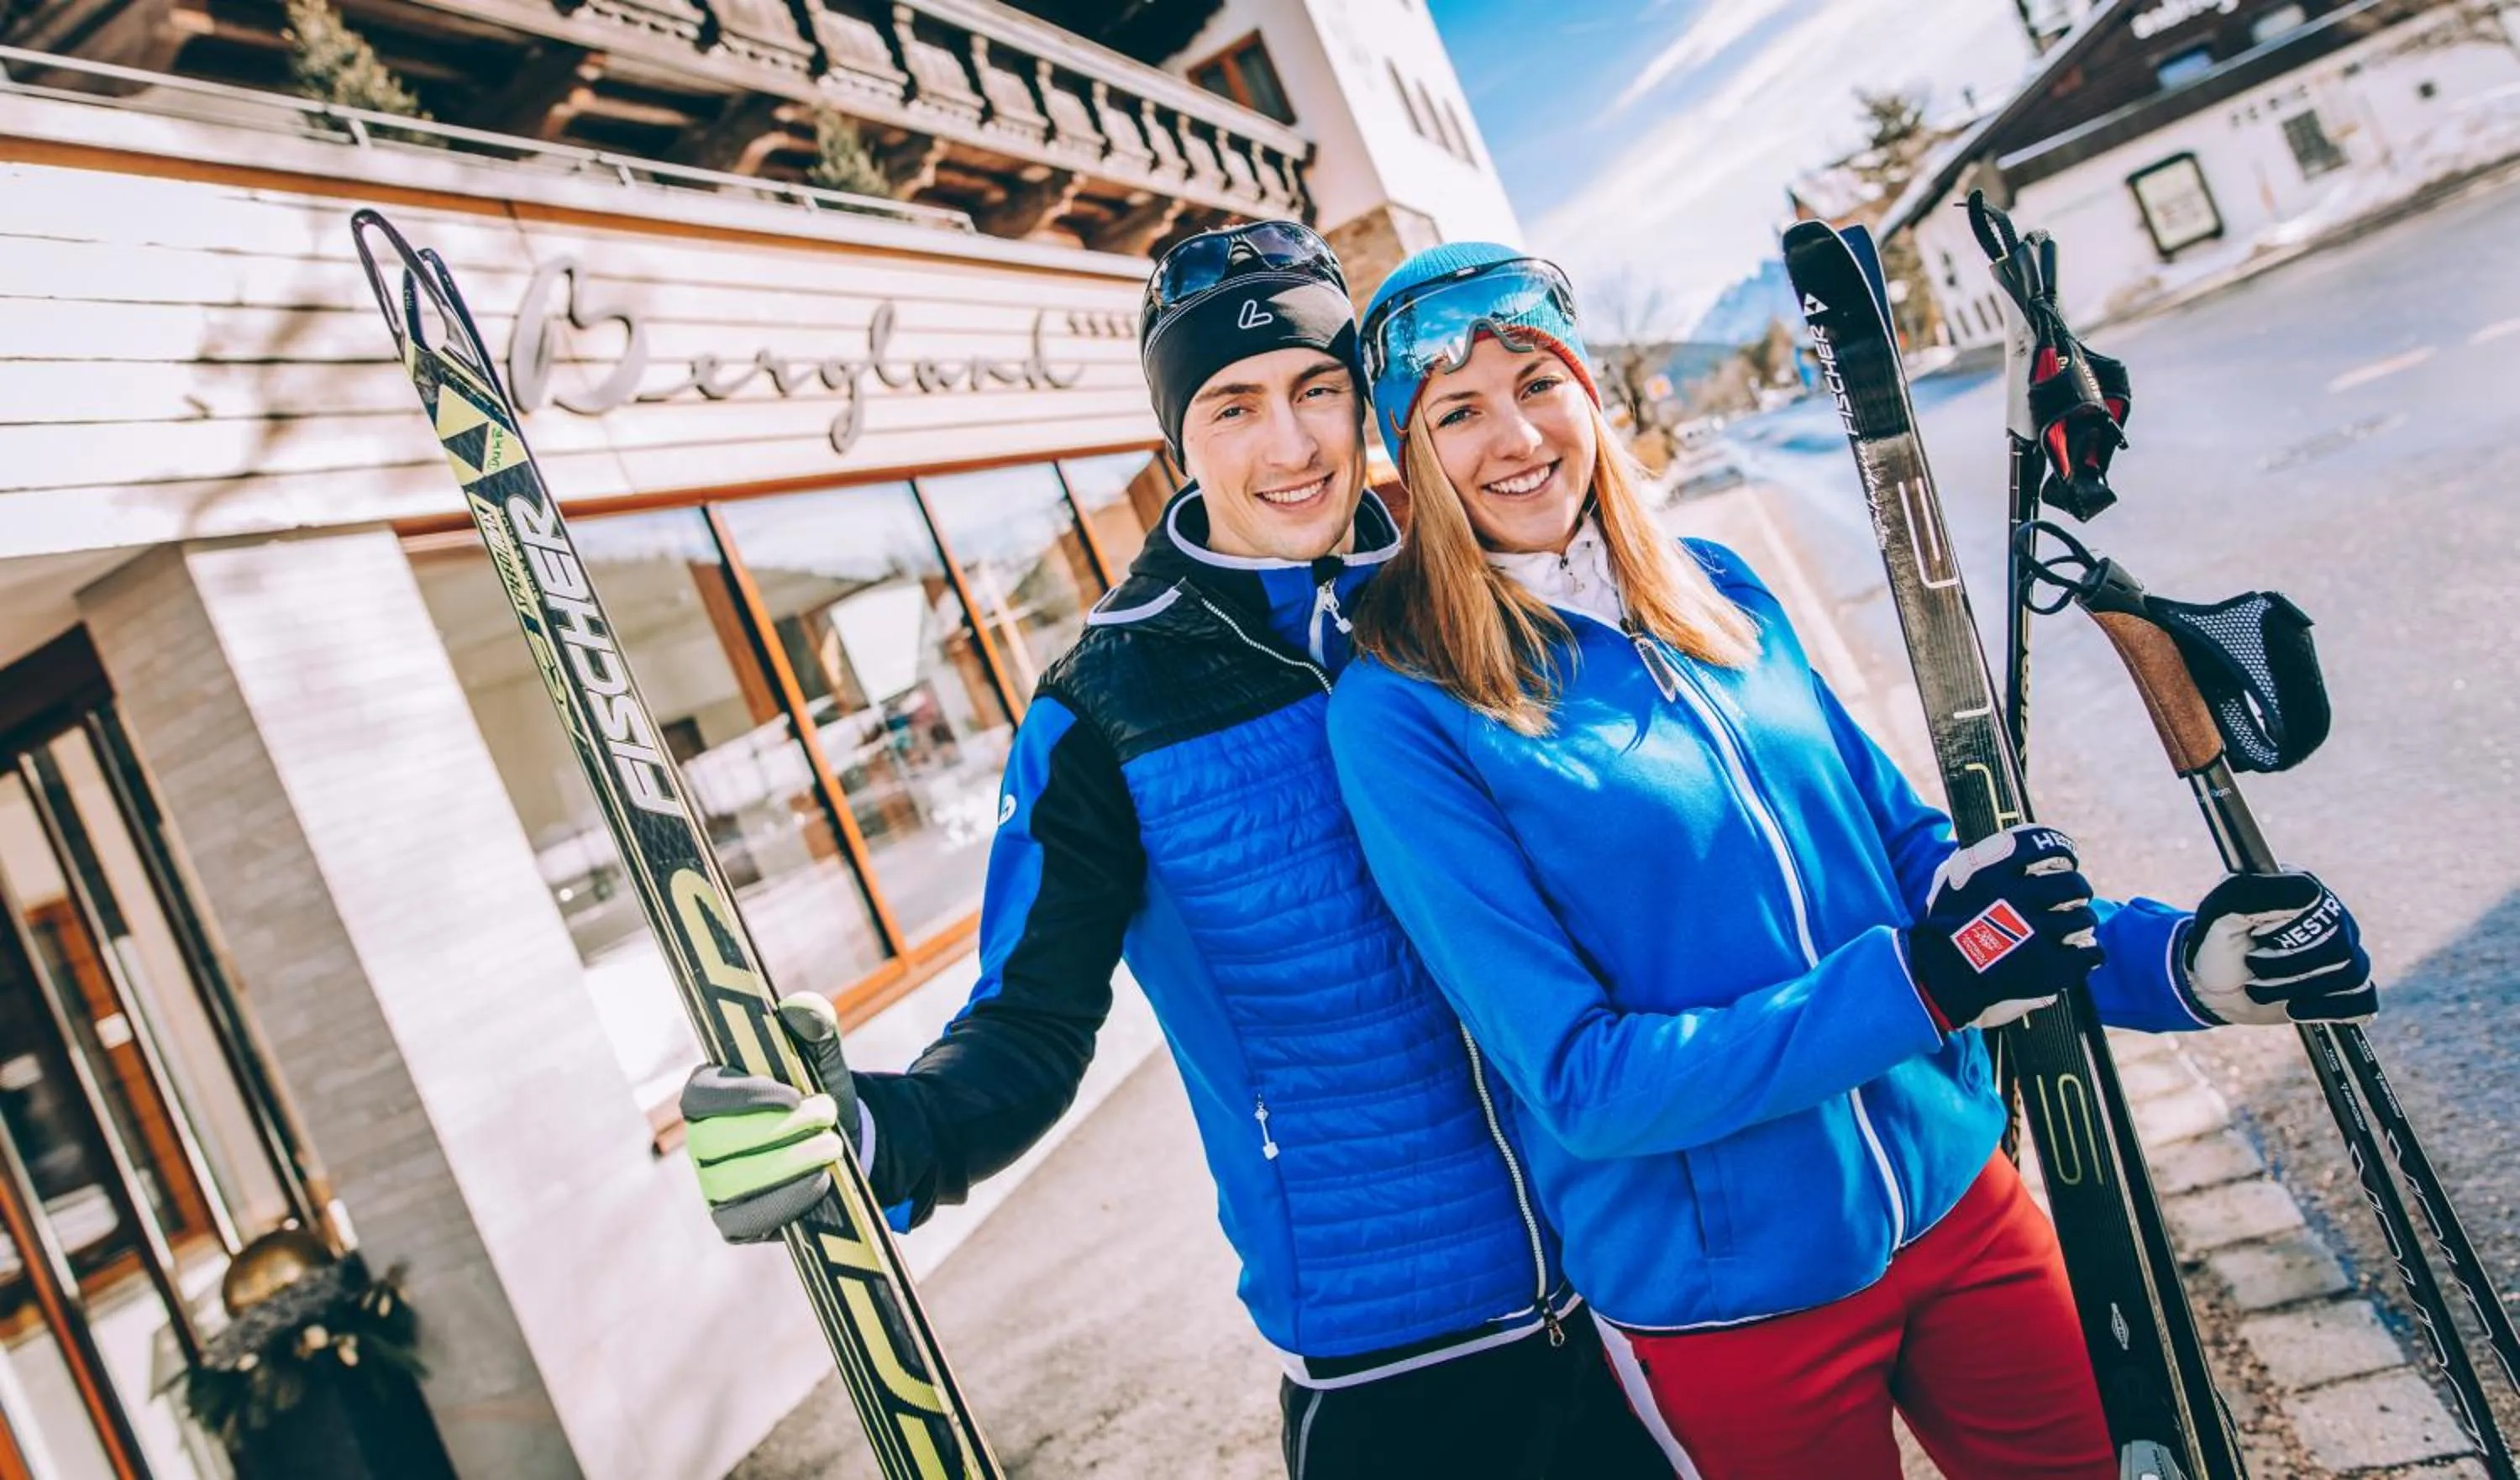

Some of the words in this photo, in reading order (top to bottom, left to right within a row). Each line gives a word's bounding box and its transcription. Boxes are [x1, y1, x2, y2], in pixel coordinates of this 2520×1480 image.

[507, 255, 1085, 455] Bergland
[1809, 324, 1860, 436] FISCHER
[507, 493, 685, 817] FISCHER
[2273, 890, 2341, 949] HESTR
